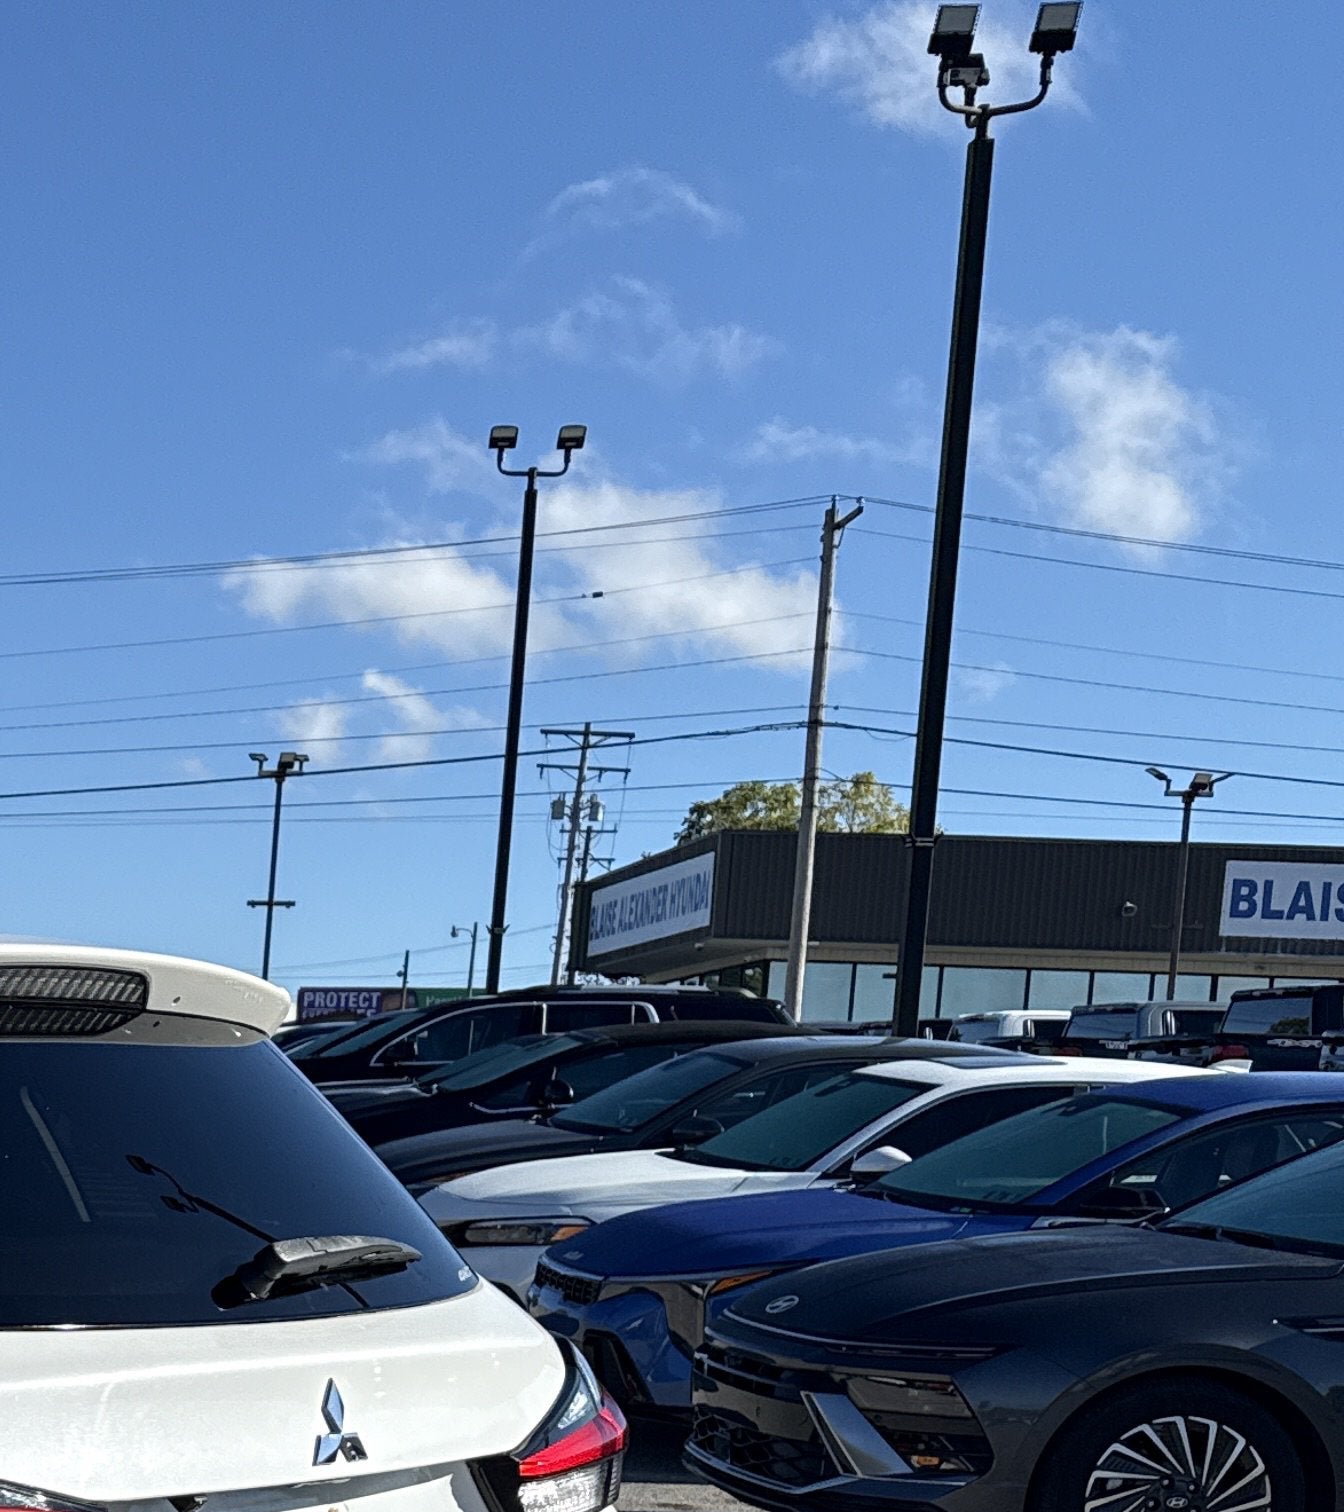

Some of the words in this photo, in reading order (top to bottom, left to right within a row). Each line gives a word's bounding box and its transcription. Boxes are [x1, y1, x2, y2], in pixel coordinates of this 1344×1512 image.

[590, 899, 618, 940] BLAISE
[618, 884, 669, 934] ALEXANDER
[669, 870, 712, 920] HYUNDAI
[303, 991, 382, 1009] PROTECT
